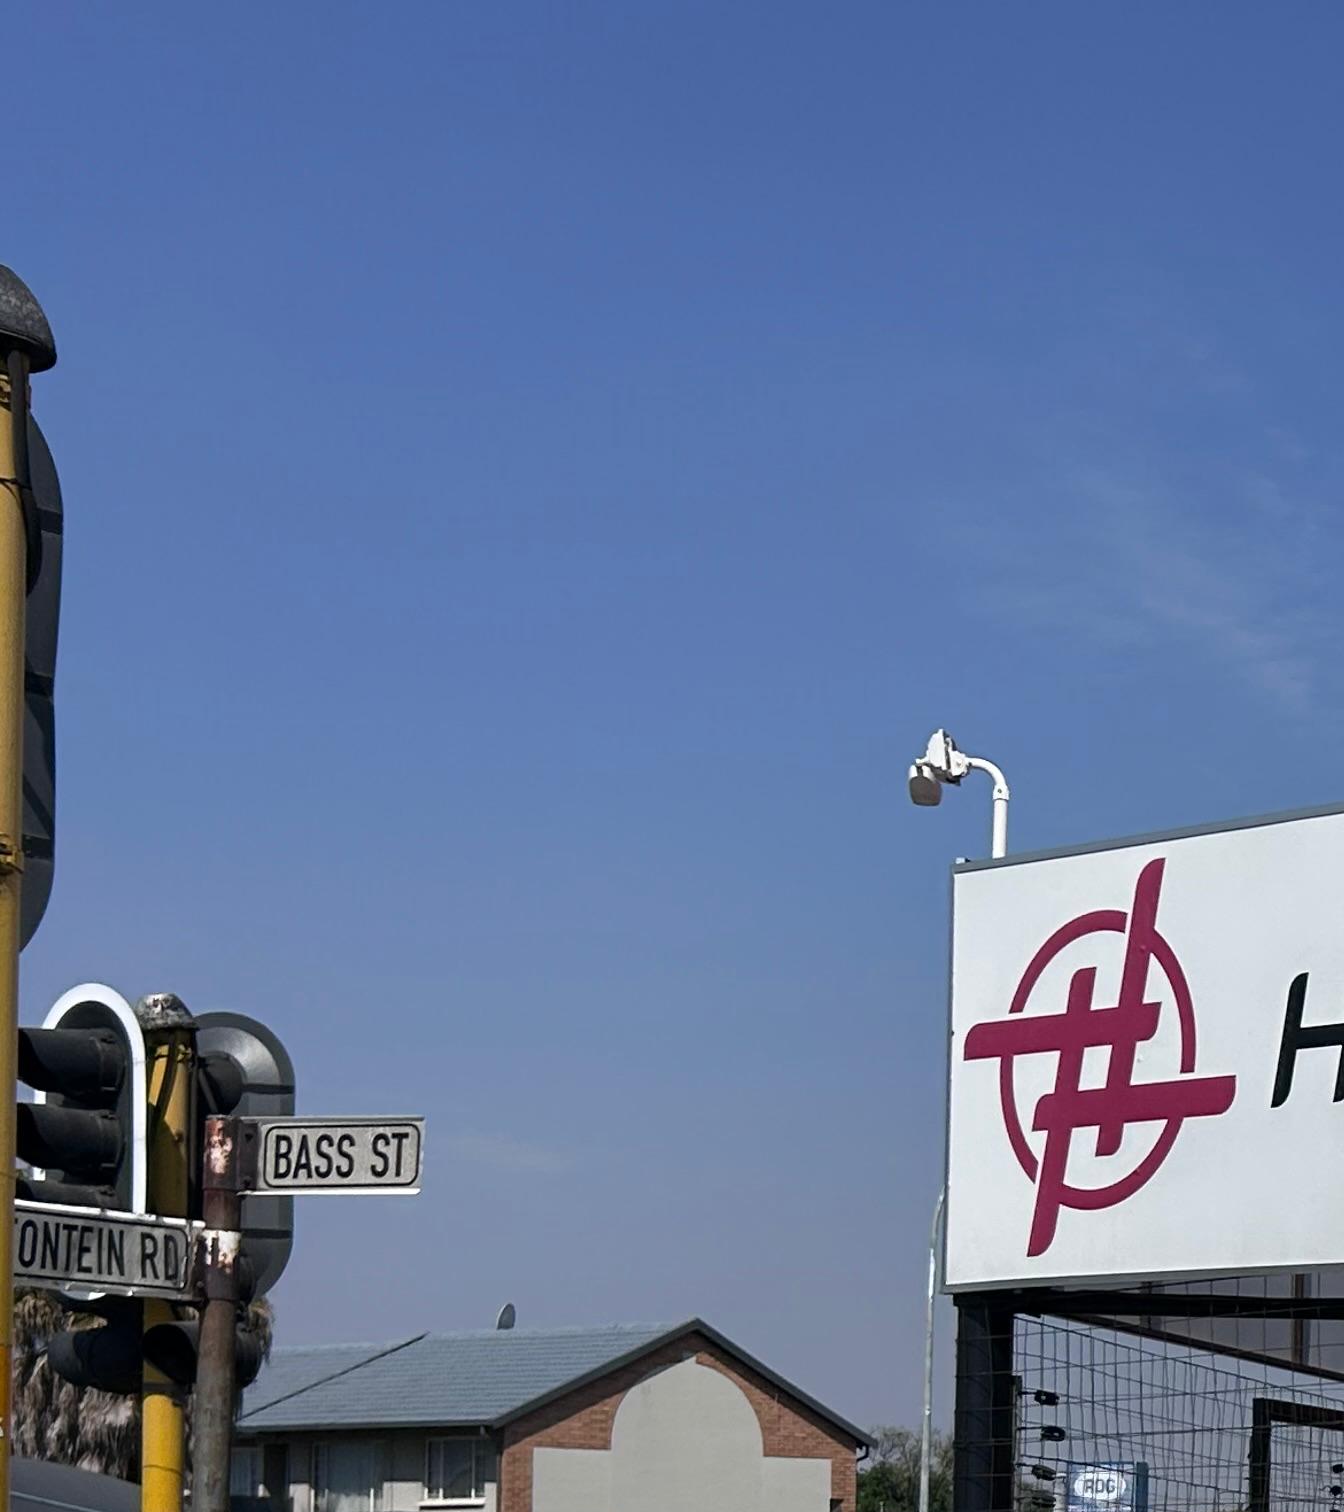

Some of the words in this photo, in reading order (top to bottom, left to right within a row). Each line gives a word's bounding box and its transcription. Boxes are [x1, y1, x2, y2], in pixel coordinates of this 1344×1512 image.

[273, 1133, 354, 1179] BASS
[370, 1132, 409, 1178] ST
[15, 1217, 126, 1277] ONTEIN
[140, 1231, 179, 1281] RD
